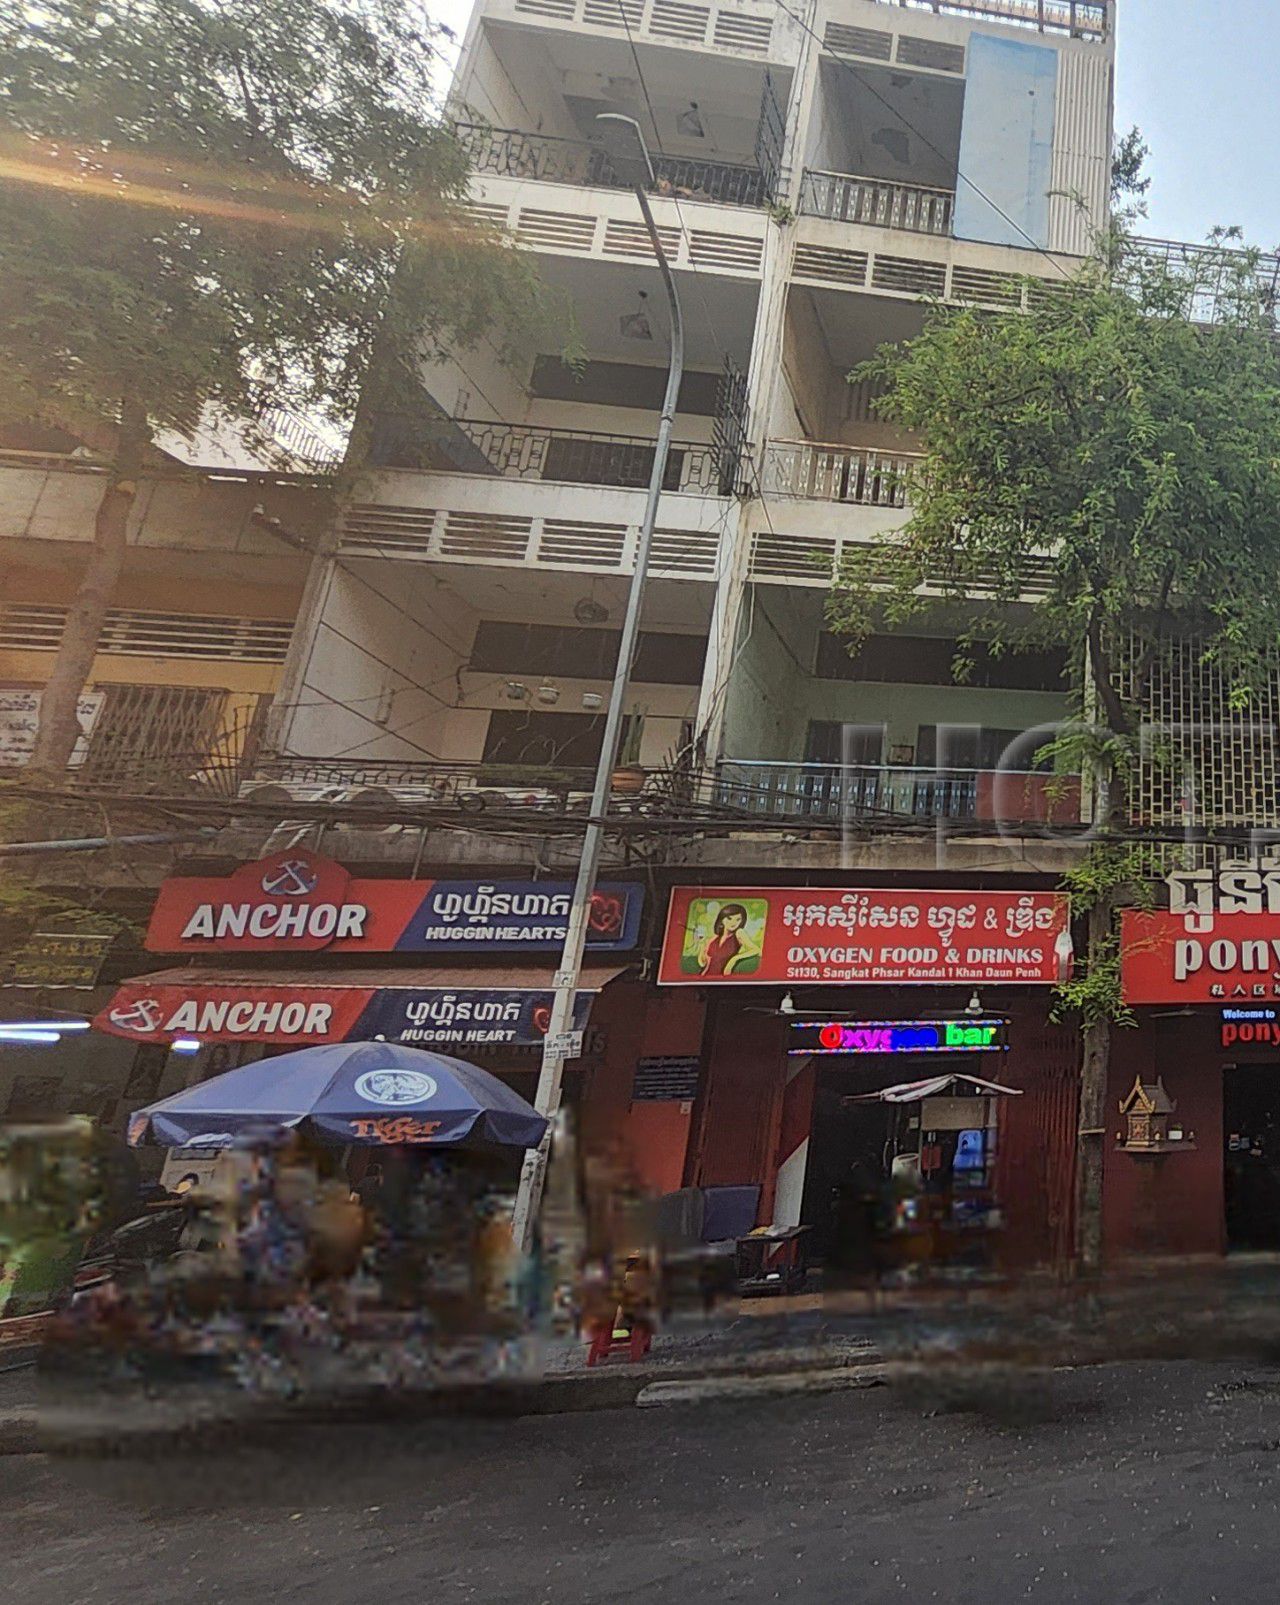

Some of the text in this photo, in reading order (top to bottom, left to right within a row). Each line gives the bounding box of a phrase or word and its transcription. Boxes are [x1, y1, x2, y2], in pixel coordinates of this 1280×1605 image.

[181, 903, 367, 938] ANCHOR
[983, 907, 998, 930] &
[426, 926, 567, 940] HUGGIN HEARTS
[786, 946, 1043, 965] OXYGEN FOOD & DRINKS
[786, 966, 1042, 981] St130, Sangkat Phsar Kandal 1 Khan Daun Penh
[163, 1000, 333, 1034] ANCHOR
[1222, 1009, 1276, 1019] Welcome to
[401, 1029, 516, 1041] HUGGIN HEART
[945, 1023, 997, 1046] bar
[349, 1117, 442, 1144] Tiger
